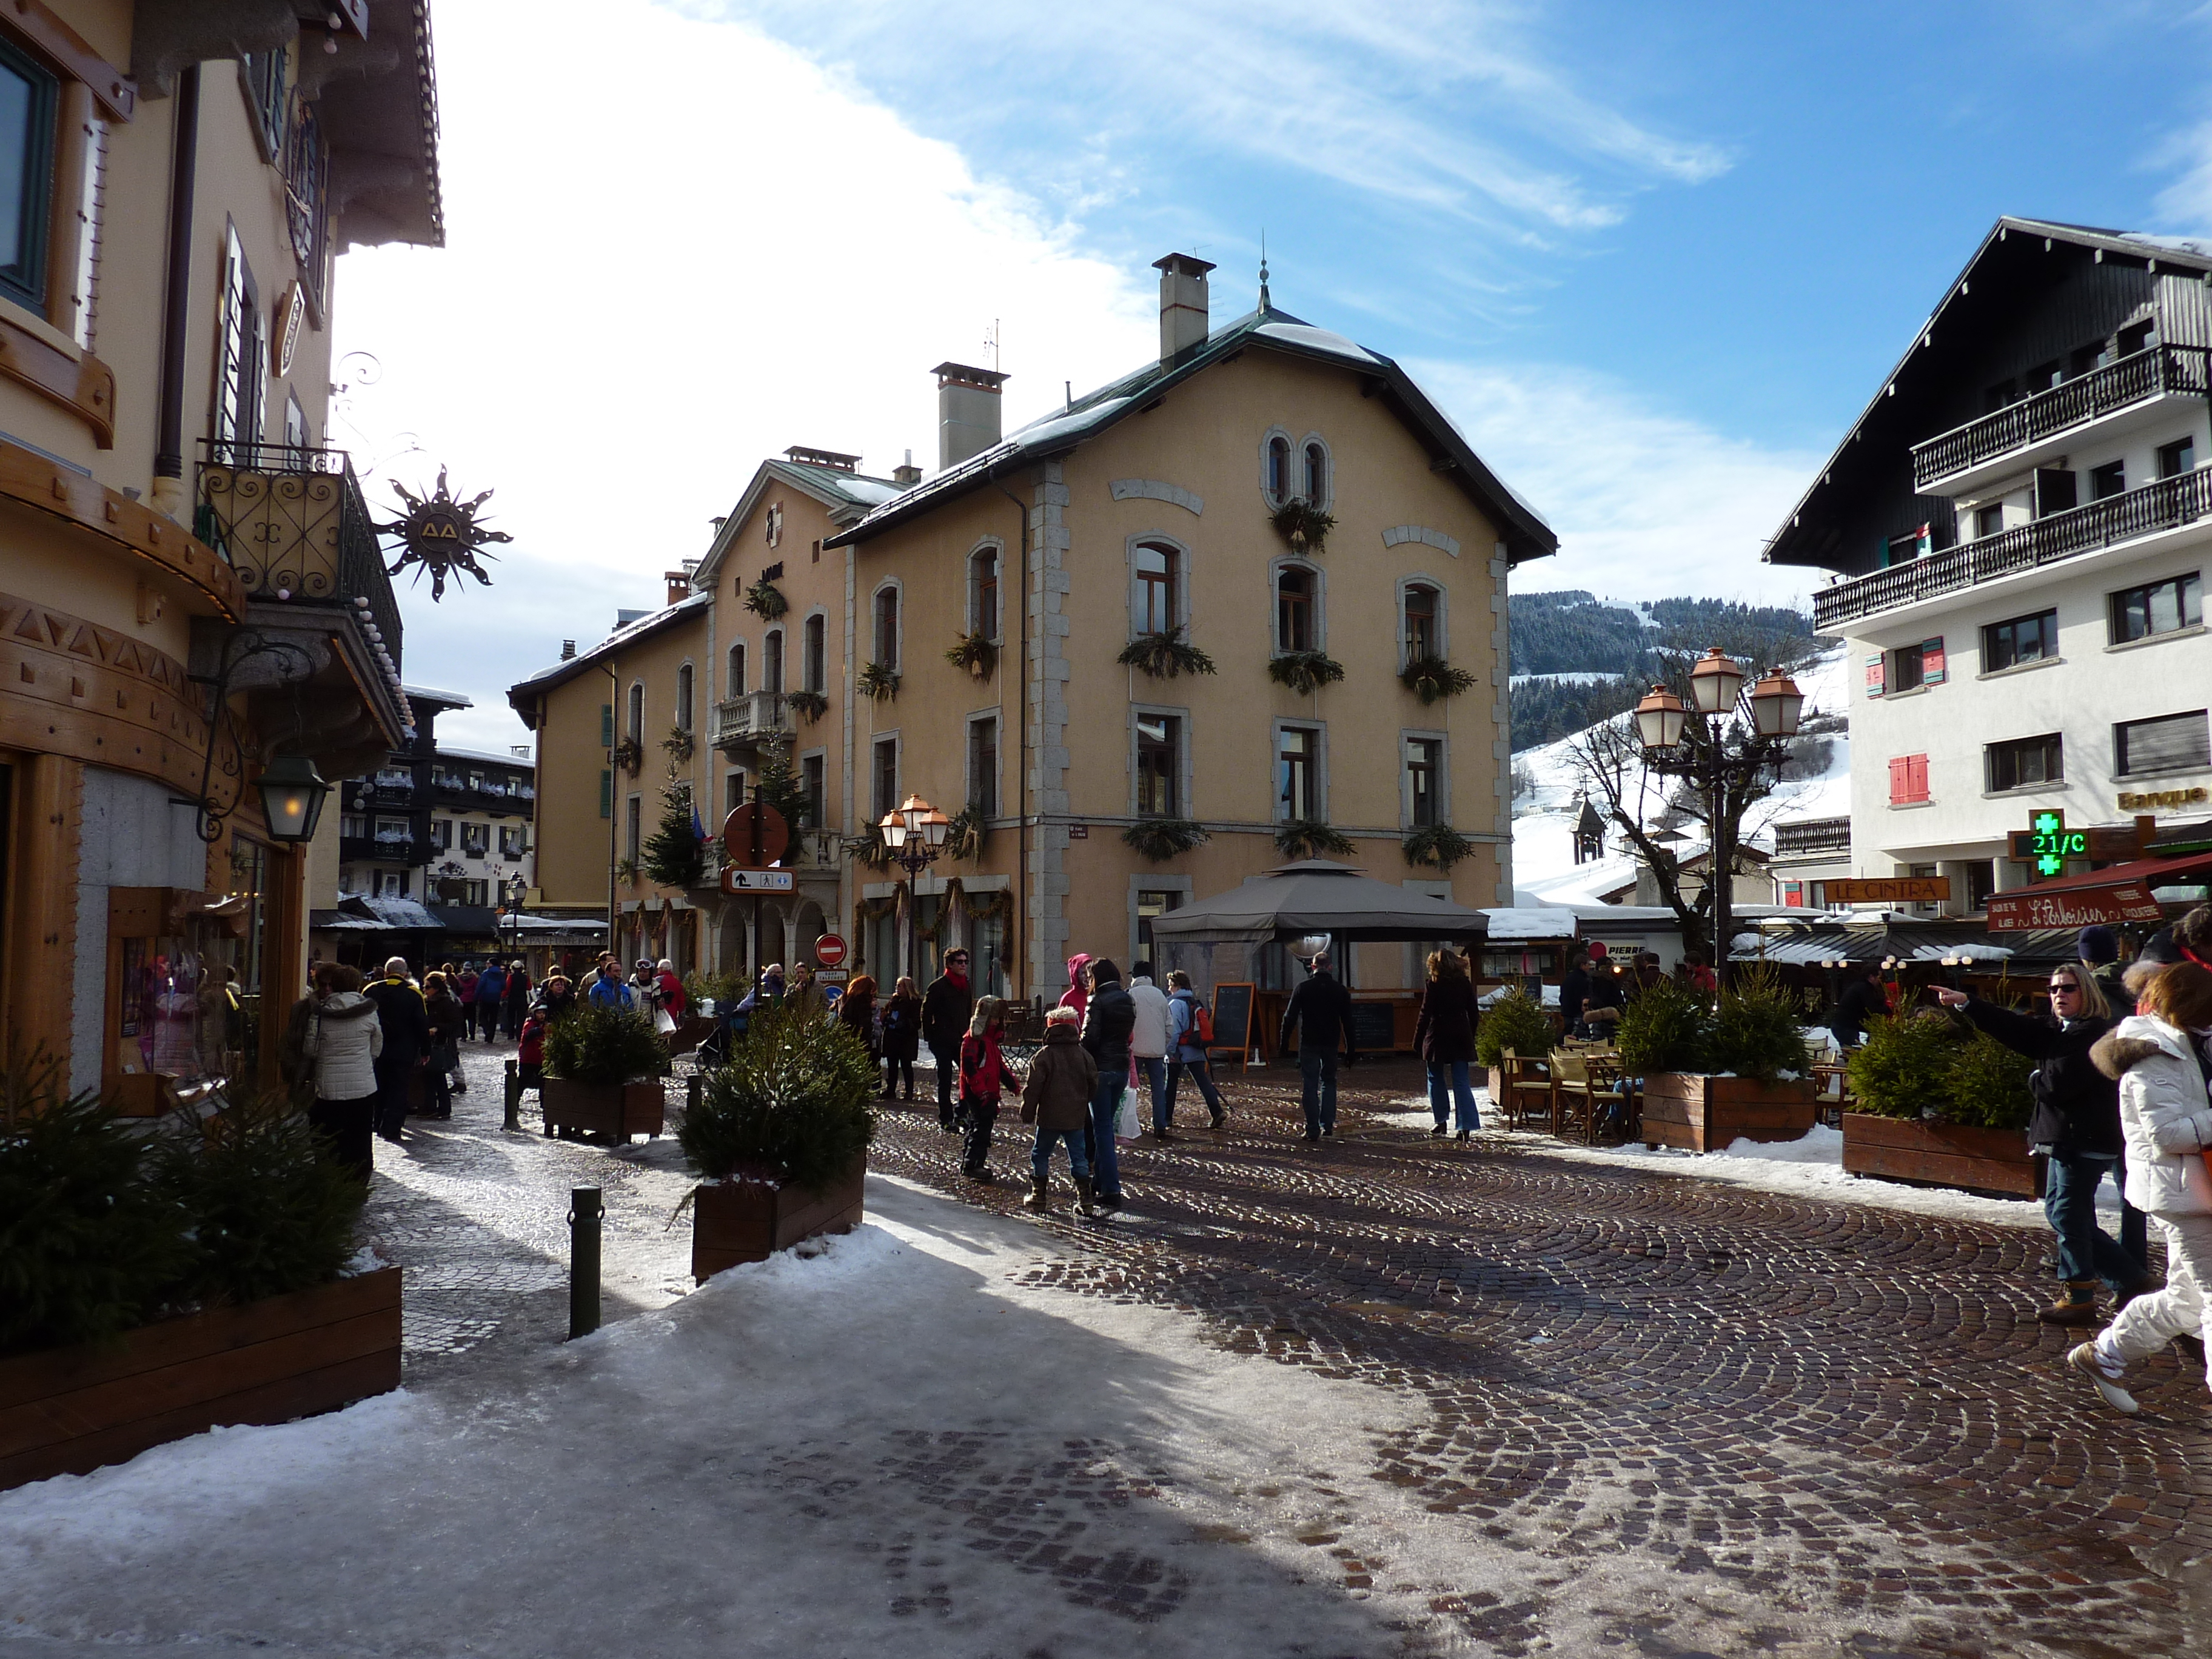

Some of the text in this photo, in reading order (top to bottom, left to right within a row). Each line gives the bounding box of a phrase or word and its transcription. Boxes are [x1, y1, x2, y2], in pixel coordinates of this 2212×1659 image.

[2117, 787, 2208, 809] Banque
[1836, 880, 1937, 899] LE CINTRA
